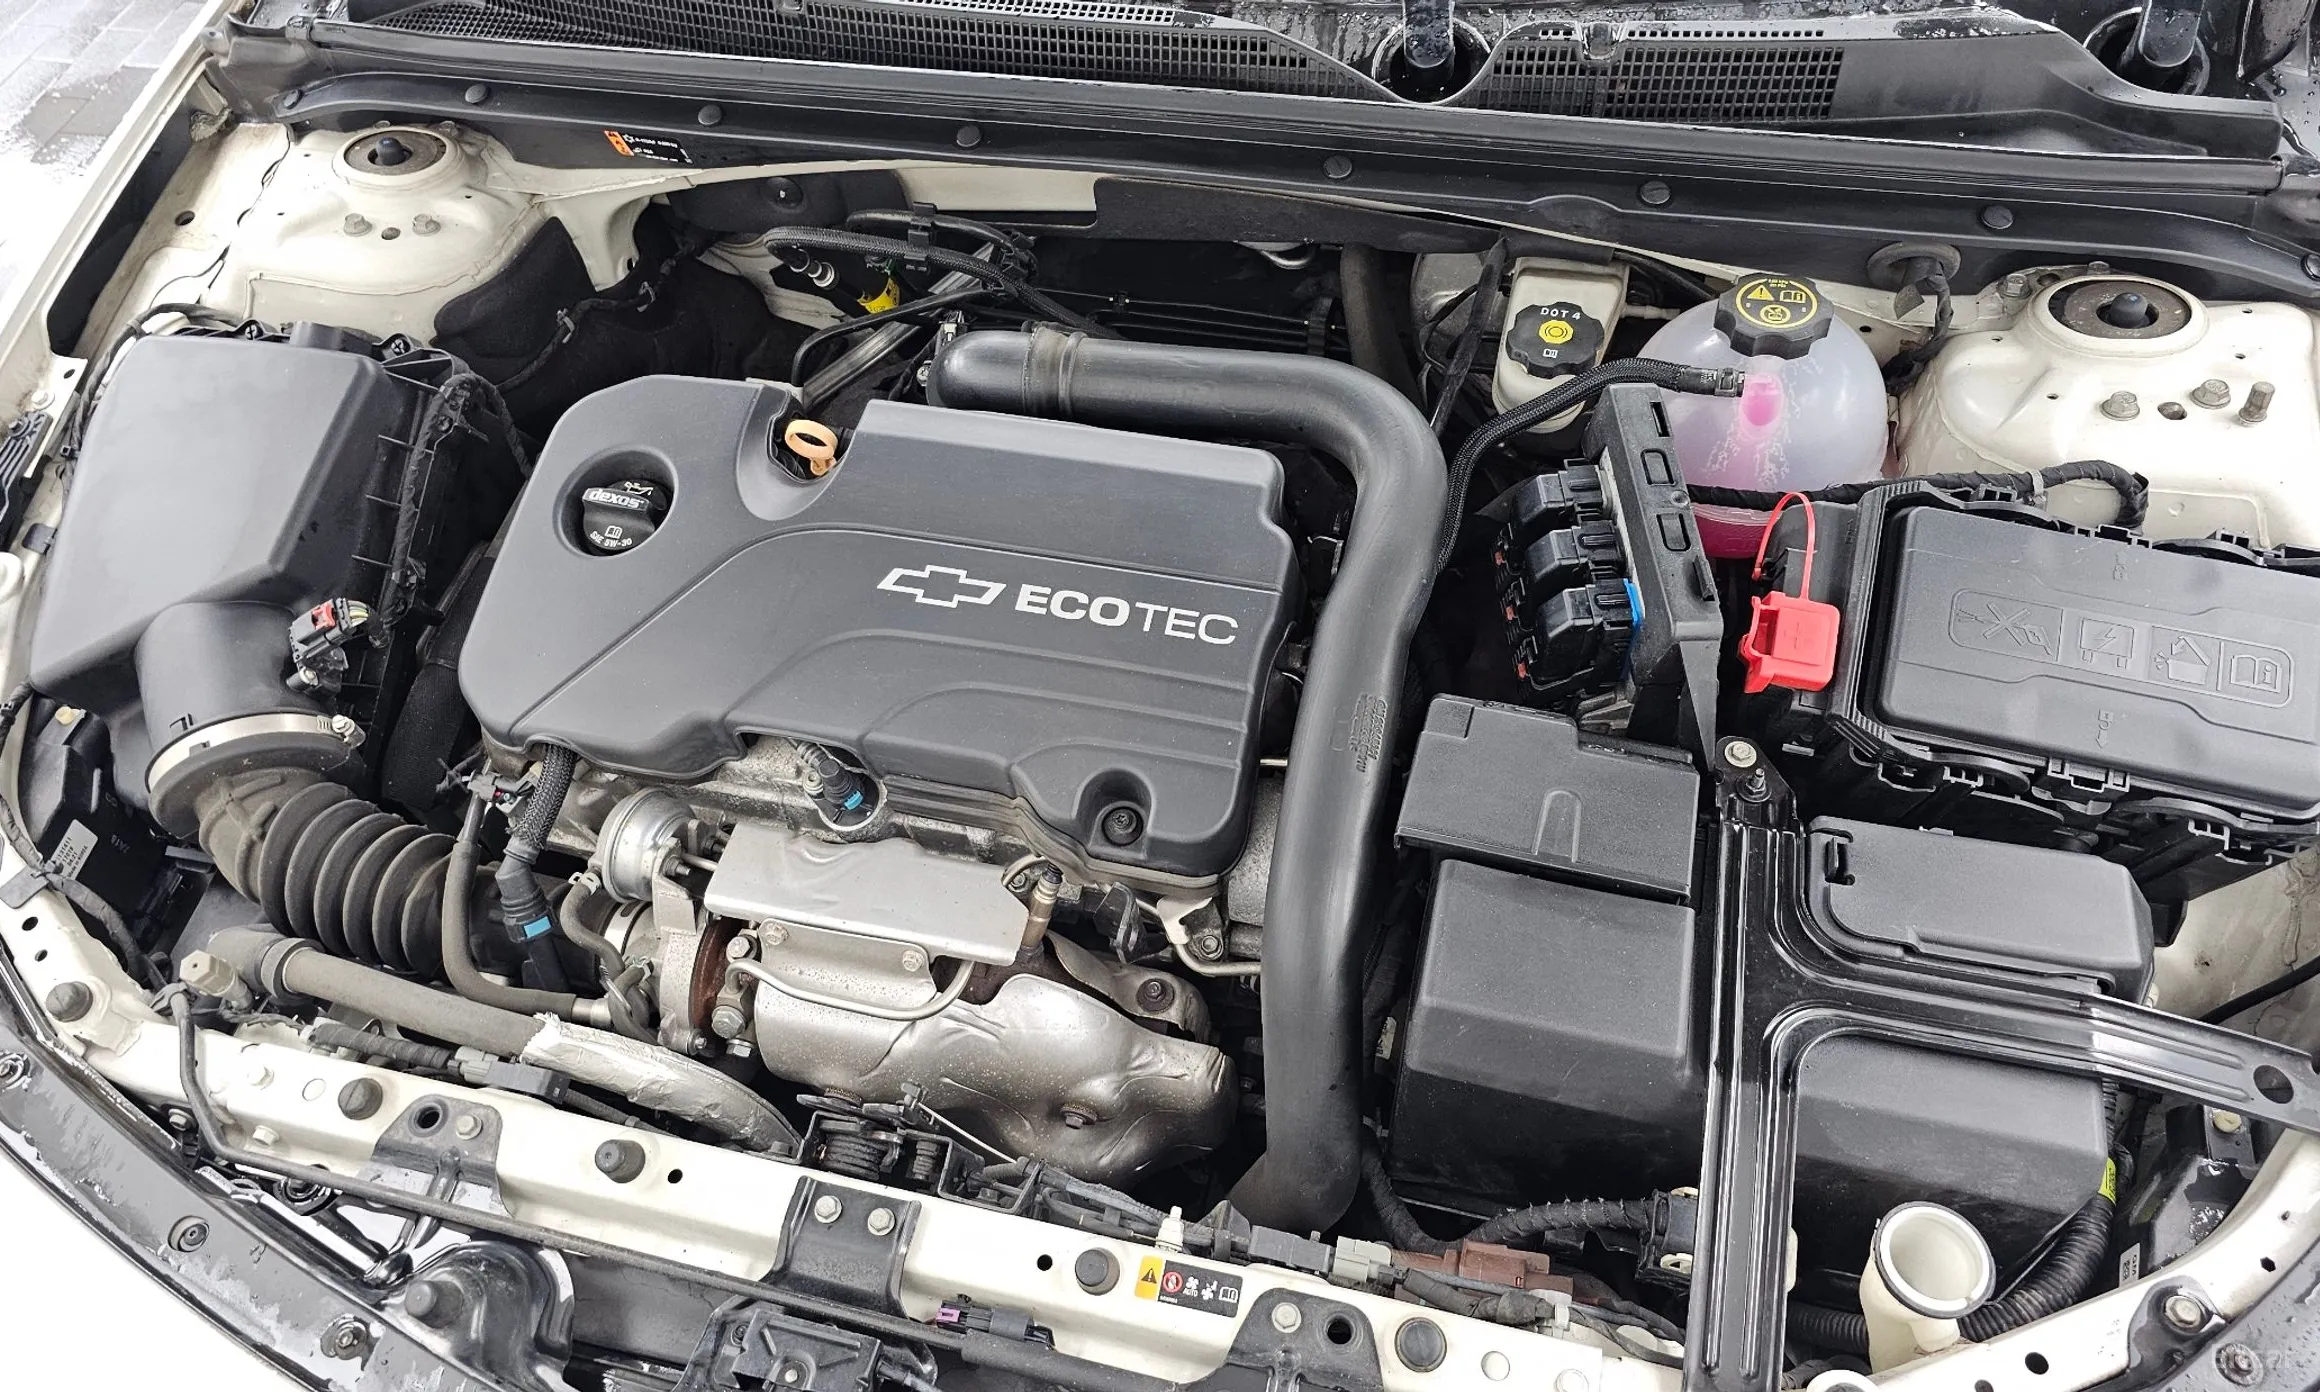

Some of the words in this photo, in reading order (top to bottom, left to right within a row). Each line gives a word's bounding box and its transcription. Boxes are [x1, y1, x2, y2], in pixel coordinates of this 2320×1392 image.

[1540, 307, 1569, 318] DOT
[1571, 312, 1581, 320] 4
[588, 488, 641, 509] dexos
[589, 530, 605, 544] SAE
[604, 537, 633, 548] 5W-30
[1014, 583, 1239, 645] ECOTEC
[1182, 1287, 1199, 1298] AUTO
